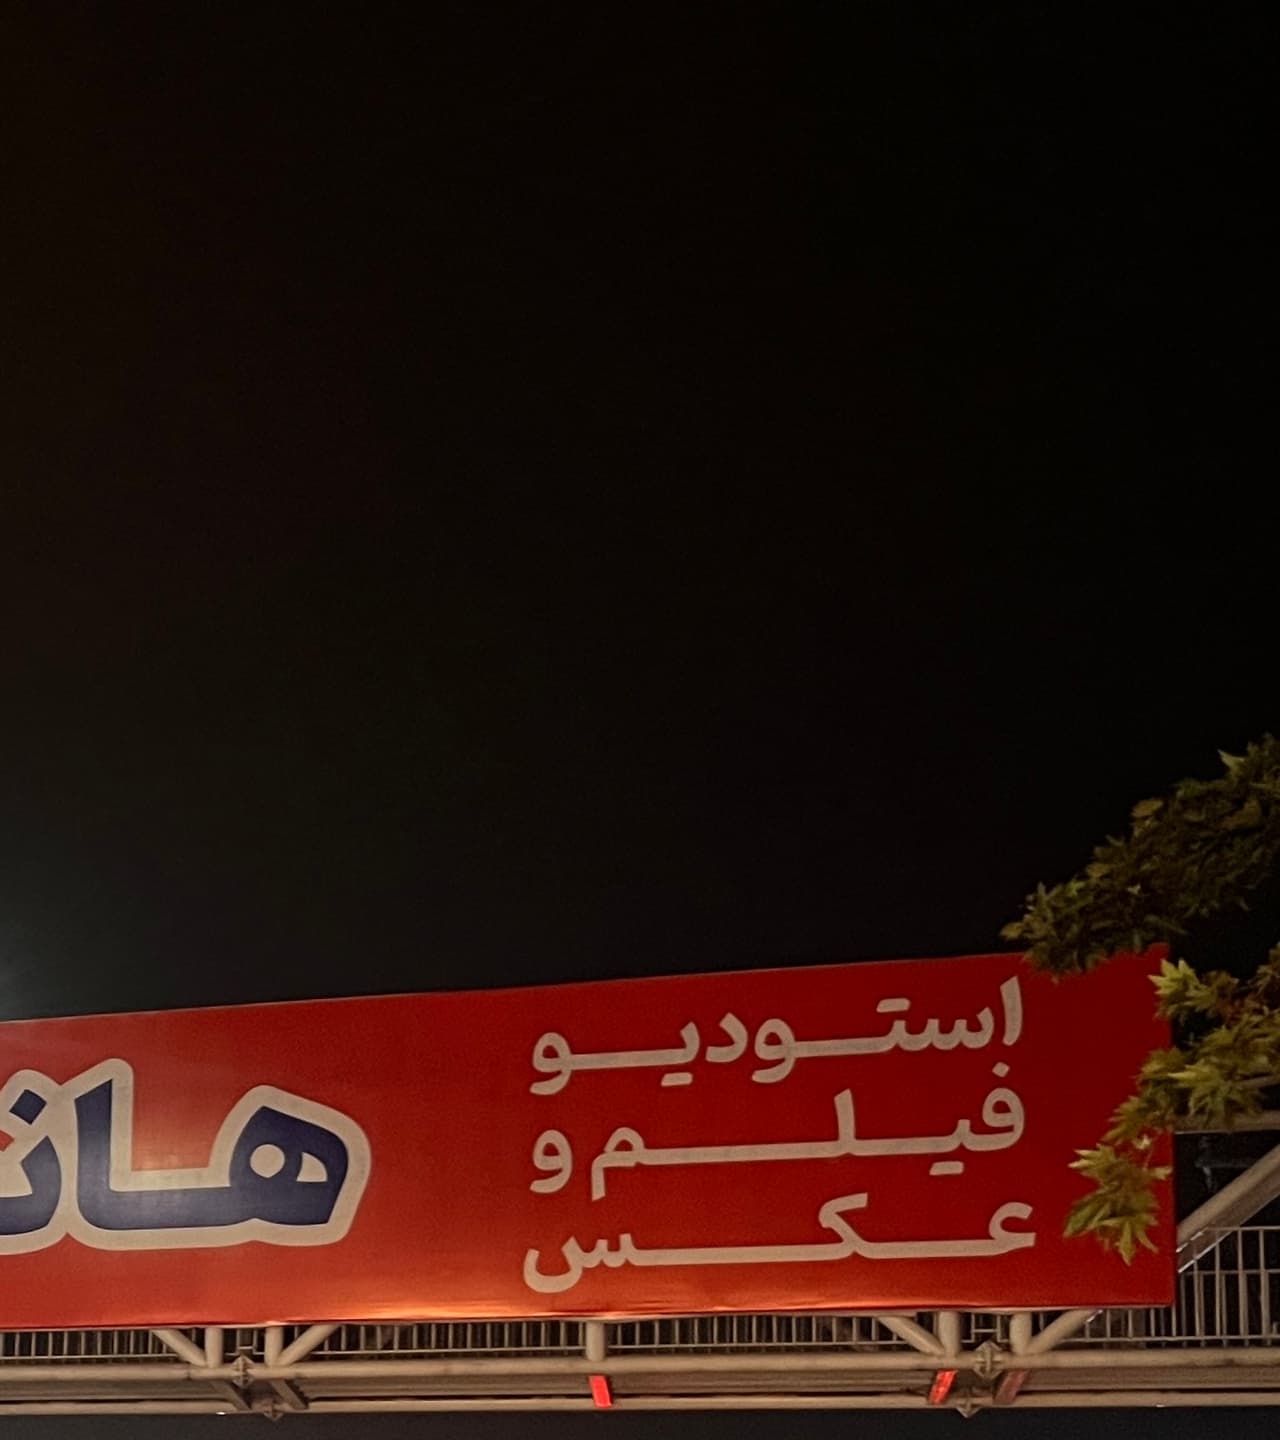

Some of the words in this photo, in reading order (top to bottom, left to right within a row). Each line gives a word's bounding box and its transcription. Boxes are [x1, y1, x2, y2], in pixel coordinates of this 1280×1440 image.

[529, 975, 1024, 1096] استودیو
[529, 1129, 573, 1194] و
[590, 1061, 1026, 1202] فیلم
[522, 1192, 1038, 1294] عکس
